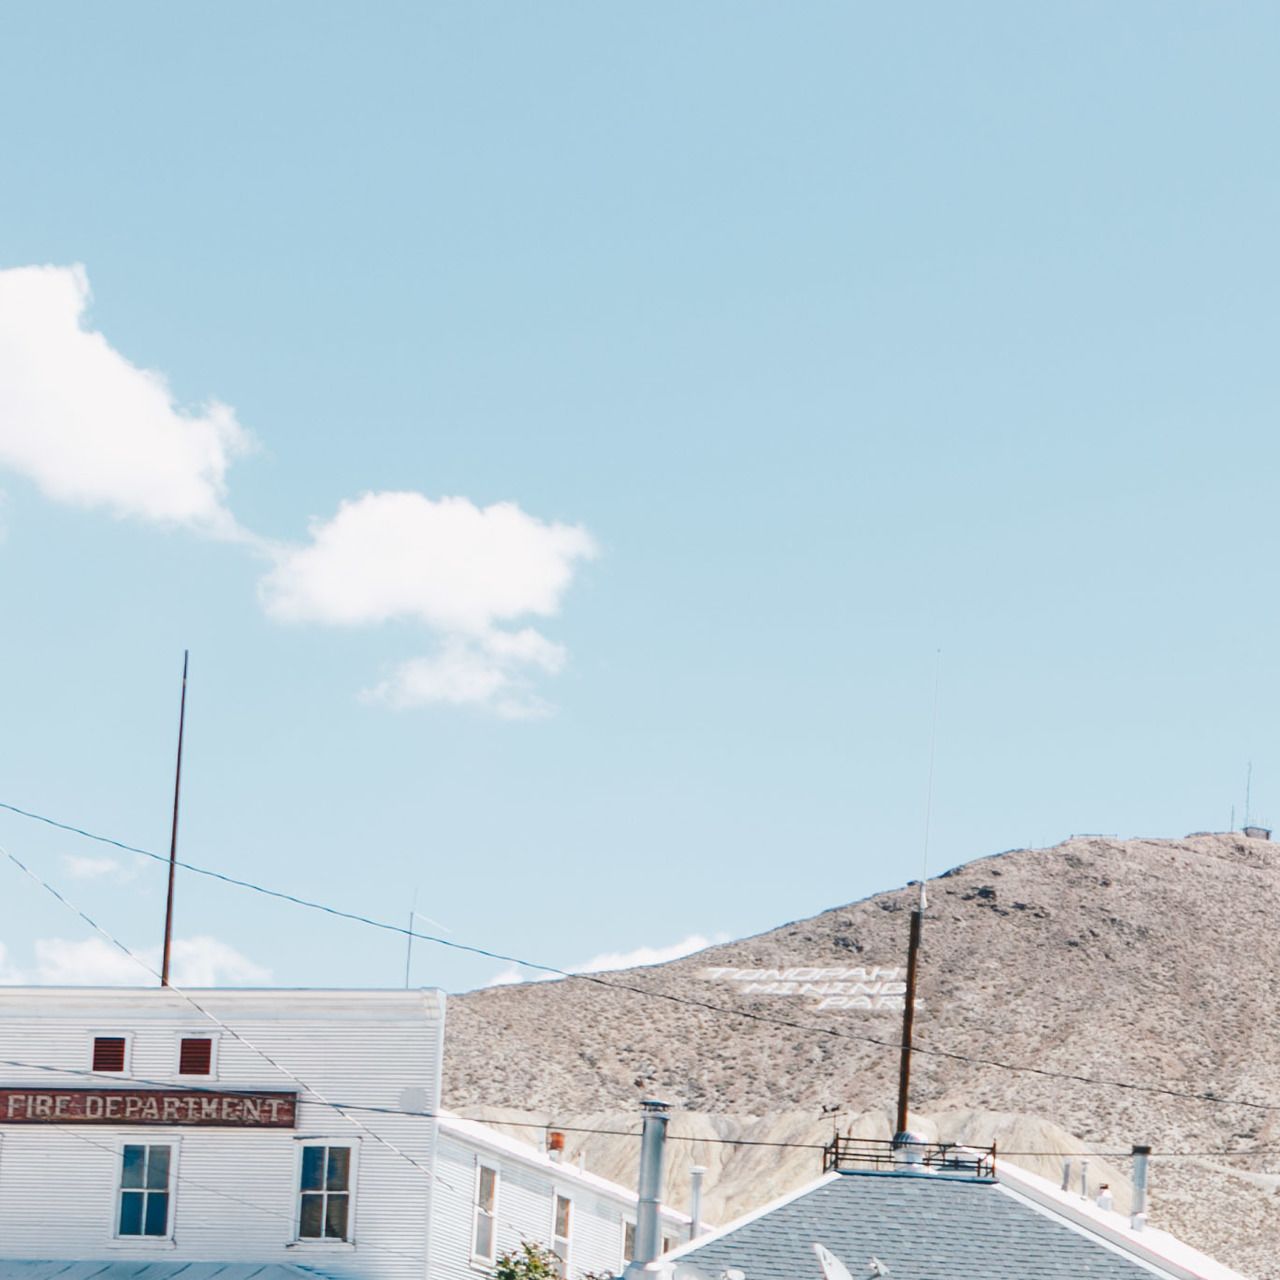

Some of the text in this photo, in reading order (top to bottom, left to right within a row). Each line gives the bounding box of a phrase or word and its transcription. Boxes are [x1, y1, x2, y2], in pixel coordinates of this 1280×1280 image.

[707, 967, 901, 980] TONOPAH
[740, 981, 907, 995] MINING
[6, 1094, 286, 1122] FIRE DEPARTMENT
